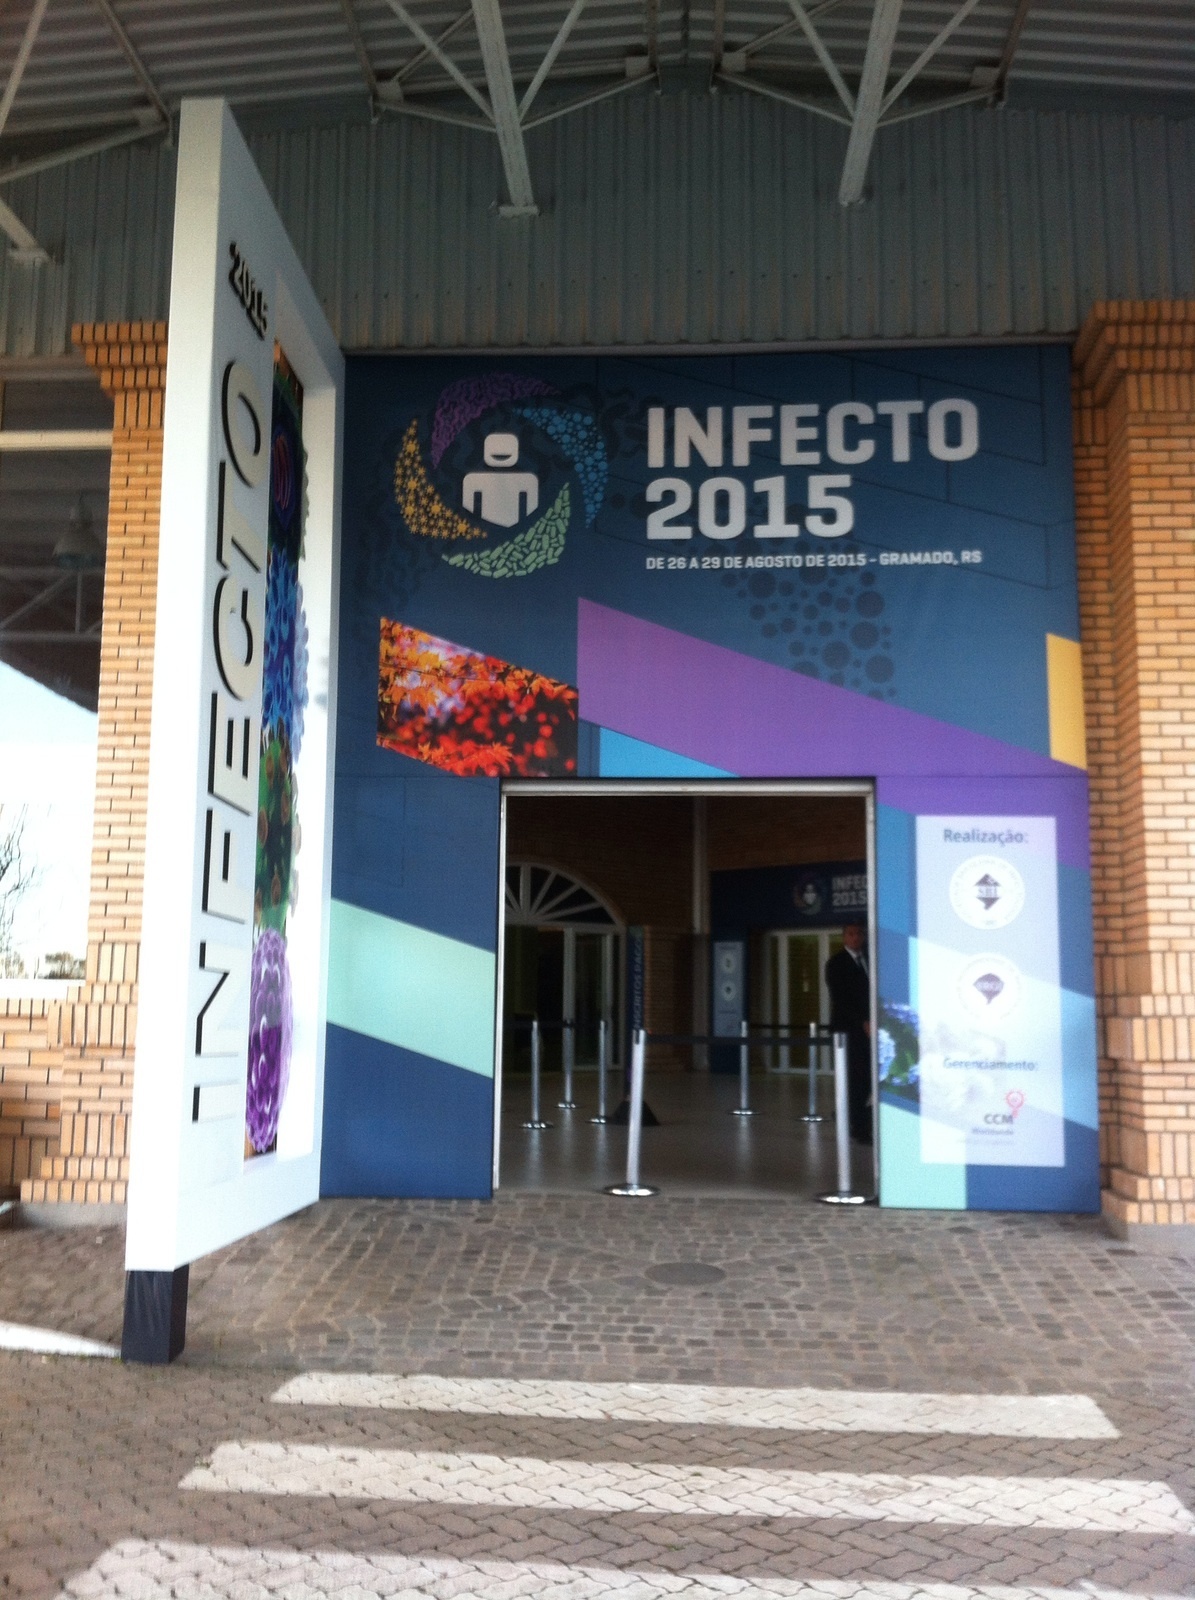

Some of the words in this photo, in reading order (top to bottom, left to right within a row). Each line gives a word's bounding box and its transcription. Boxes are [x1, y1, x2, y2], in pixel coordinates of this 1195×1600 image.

[228, 241, 268, 341] 2015
[647, 398, 980, 468] INFECTO
[646, 475, 855, 540] 2015
[645, 556, 665, 570] DE
[667, 556, 687, 570] 26
[689, 556, 699, 569] A
[701, 555, 722, 569] 29
[724, 555, 743, 569] DE
[745, 554, 802, 569] AGOSTO
[805, 554, 825, 569] DE
[827, 552, 867, 568] 2015
[879, 550, 959, 566] GRAMADO,
[961, 550, 983, 565] RS
[192, 357, 268, 1124] INFECTO
[943, 829, 1028, 847] Realização:
[984, 1114, 1014, 1125] CCM
